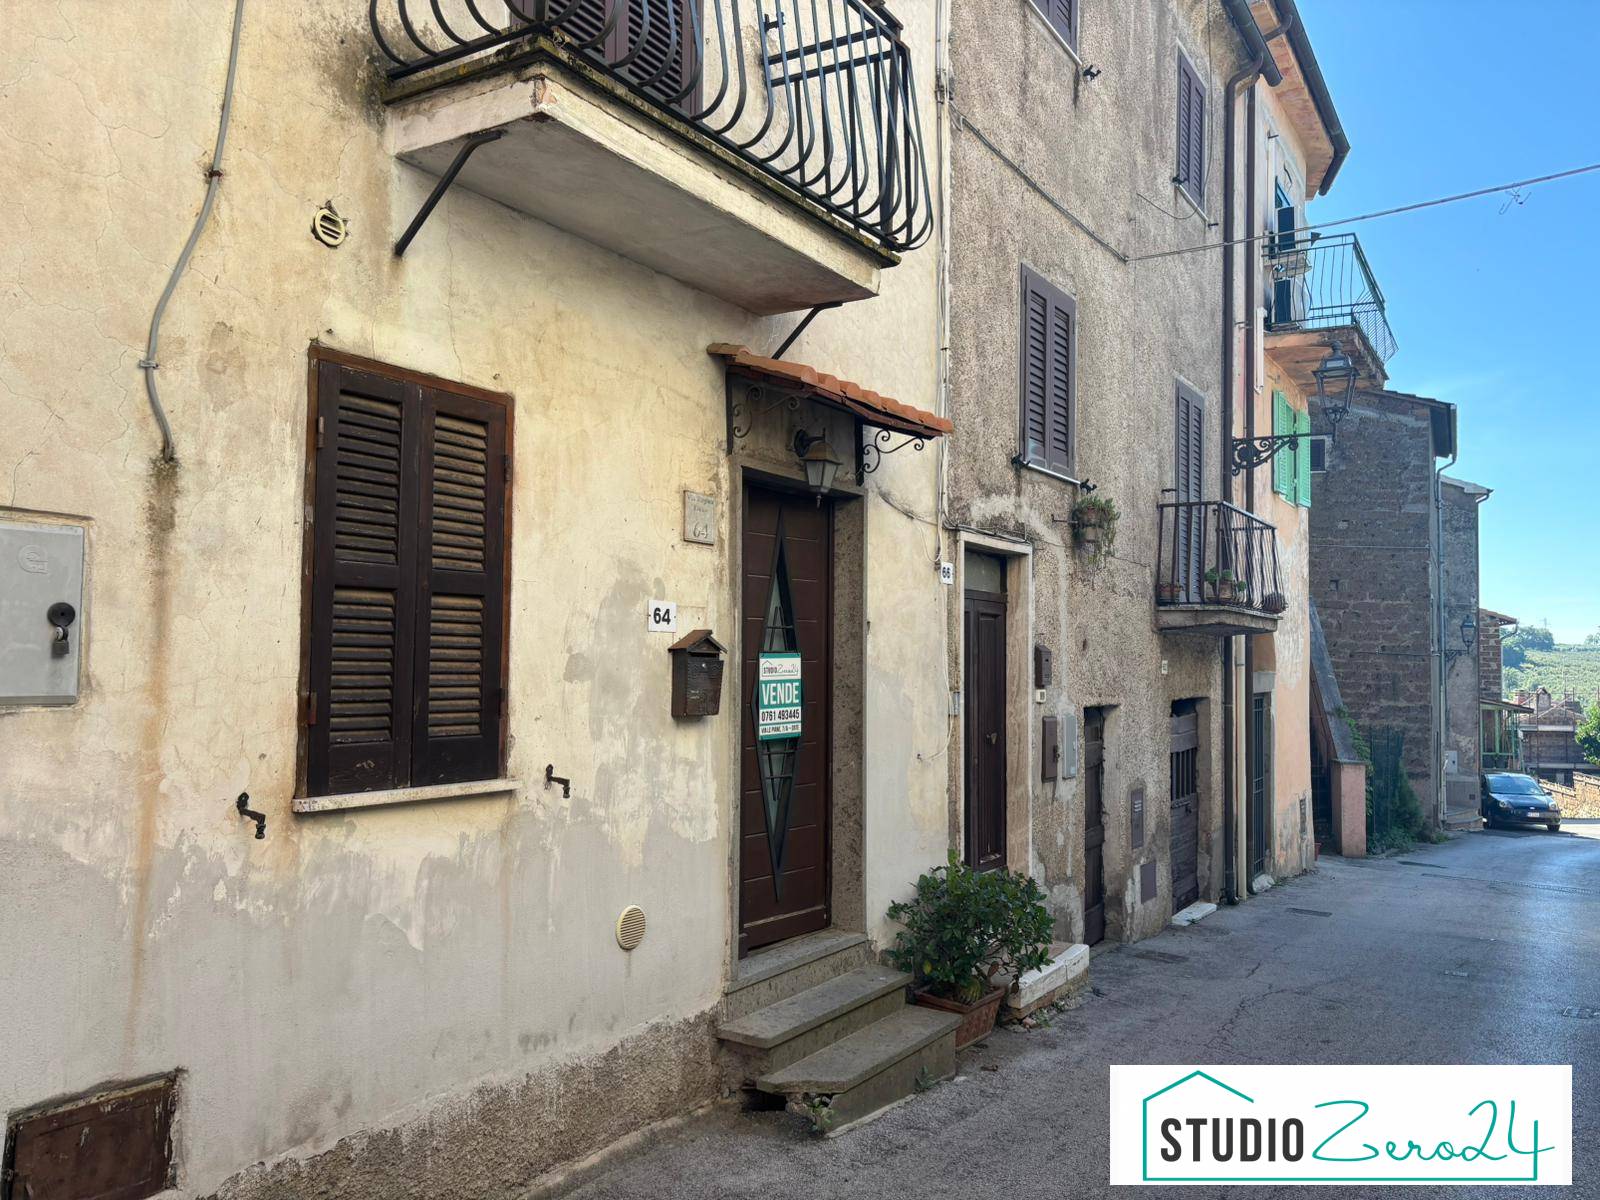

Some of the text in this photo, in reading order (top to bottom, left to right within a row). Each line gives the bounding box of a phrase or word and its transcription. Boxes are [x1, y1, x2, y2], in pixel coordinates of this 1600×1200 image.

[693, 522, 708, 539] 64
[653, 607, 671, 625] 64
[761, 683, 800, 705] VENDE
[761, 709, 800, 722] 0761 493445
